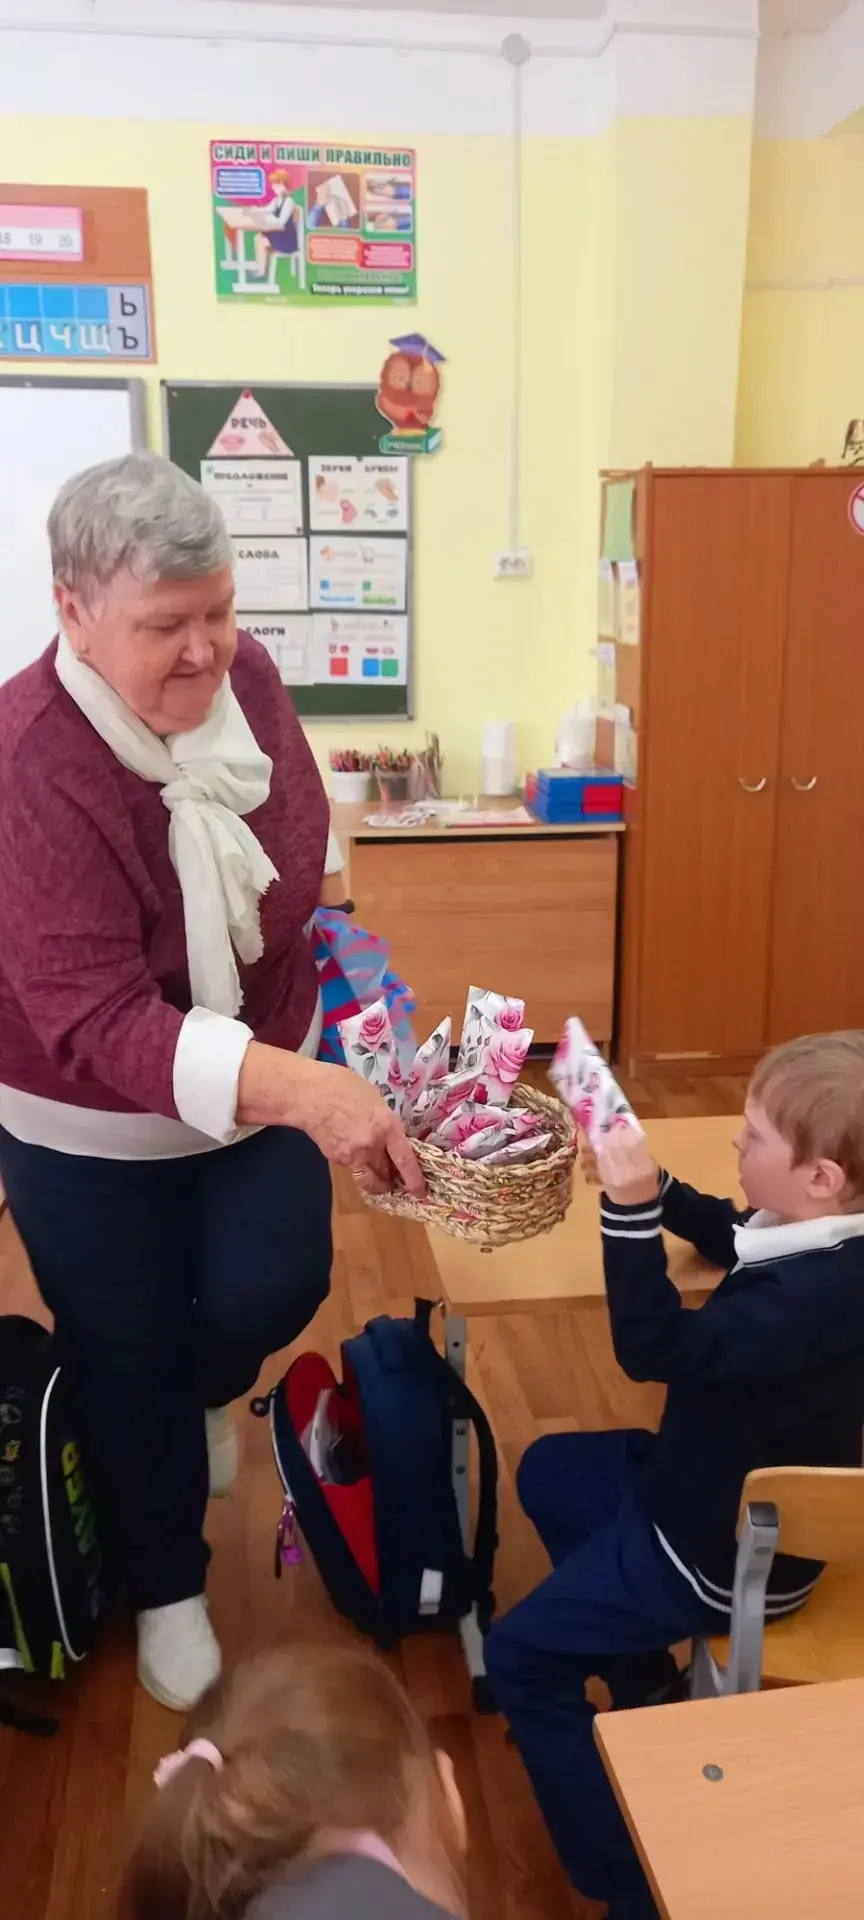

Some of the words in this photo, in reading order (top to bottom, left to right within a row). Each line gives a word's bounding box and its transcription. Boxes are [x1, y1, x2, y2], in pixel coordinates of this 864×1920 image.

[214, 145, 256, 160] СИДИ
[261, 147, 271, 160] И
[275, 148, 320, 162] ПИШИ
[326, 149, 412, 166] ПРАВИЛЬНО
[28, 234, 43, 247] 19
[57, 235, 74, 248] 20
[15, 323, 41, 353] Ц
[50, 323, 71, 351] Ч
[79, 323, 111, 353] Щ
[231, 417, 268, 430] РЕЧЬ
[238, 550, 279, 560] СЛОВА
